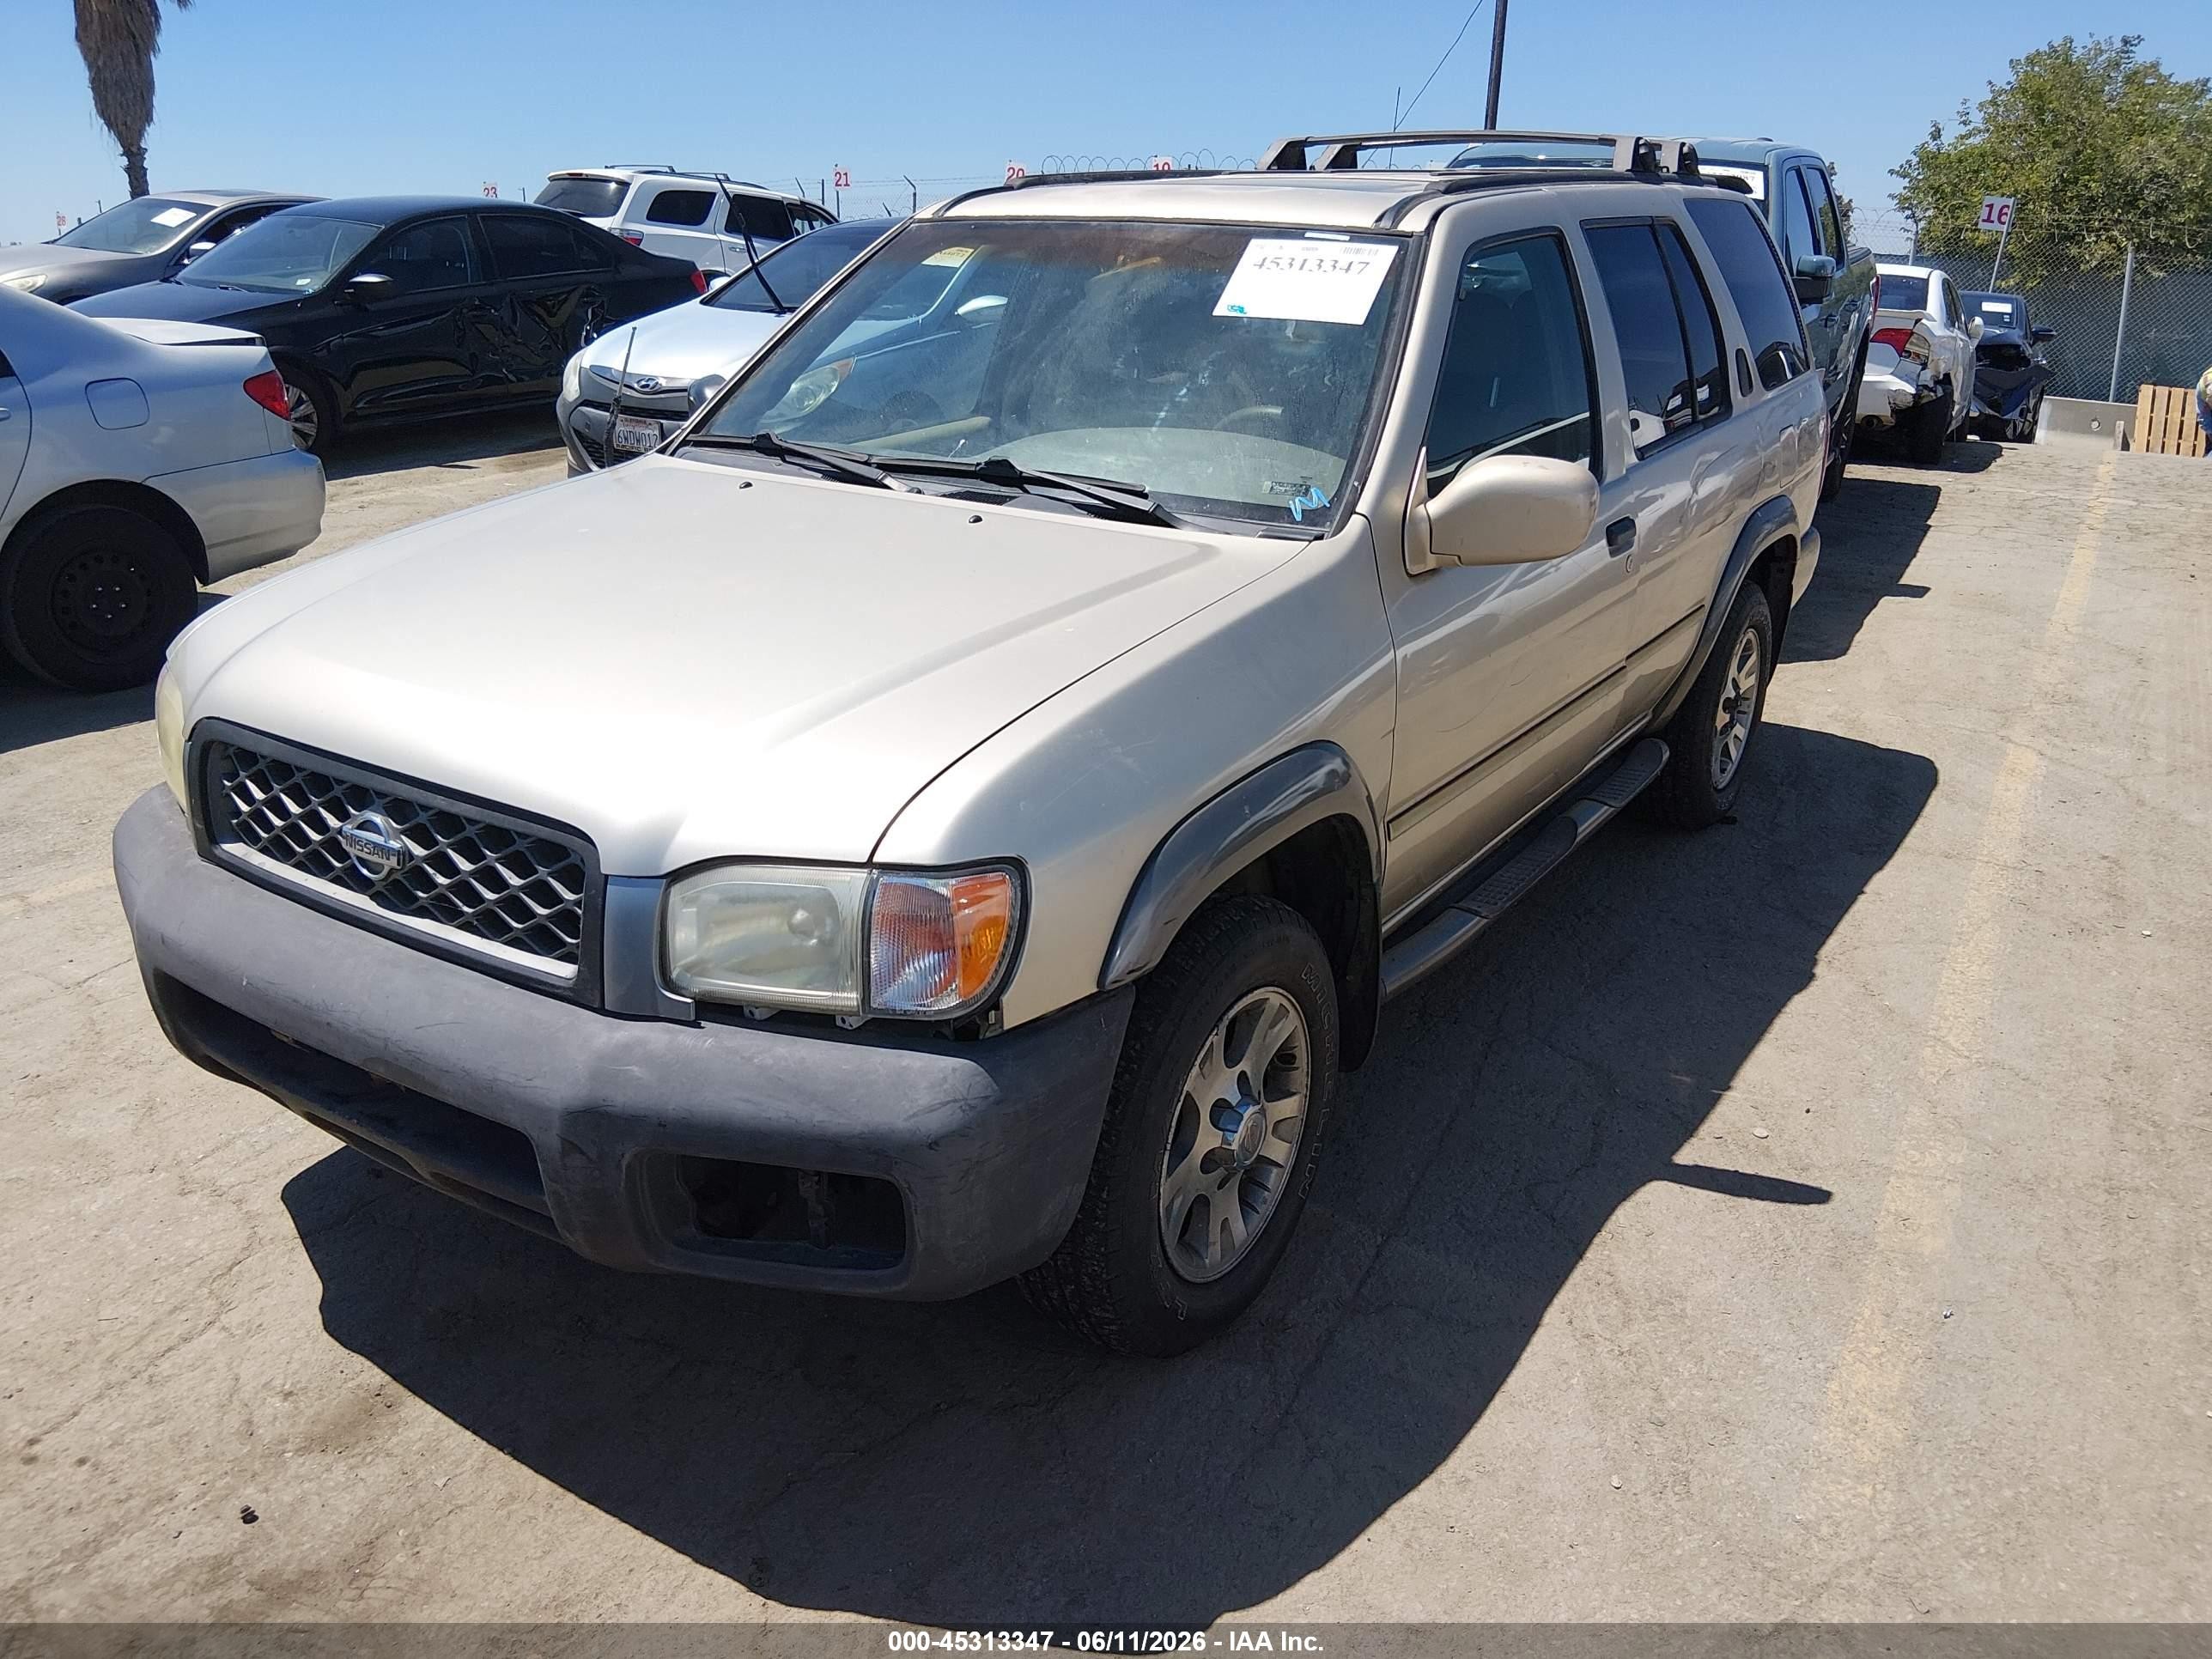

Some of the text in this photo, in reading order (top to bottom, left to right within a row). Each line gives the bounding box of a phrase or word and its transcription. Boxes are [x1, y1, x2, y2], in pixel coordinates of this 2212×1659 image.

[835, 171, 850, 187] 21
[1982, 203, 2010, 225] 16
[1253, 257, 1370, 275] 45313347
[345, 834, 392, 861] NISSAN
